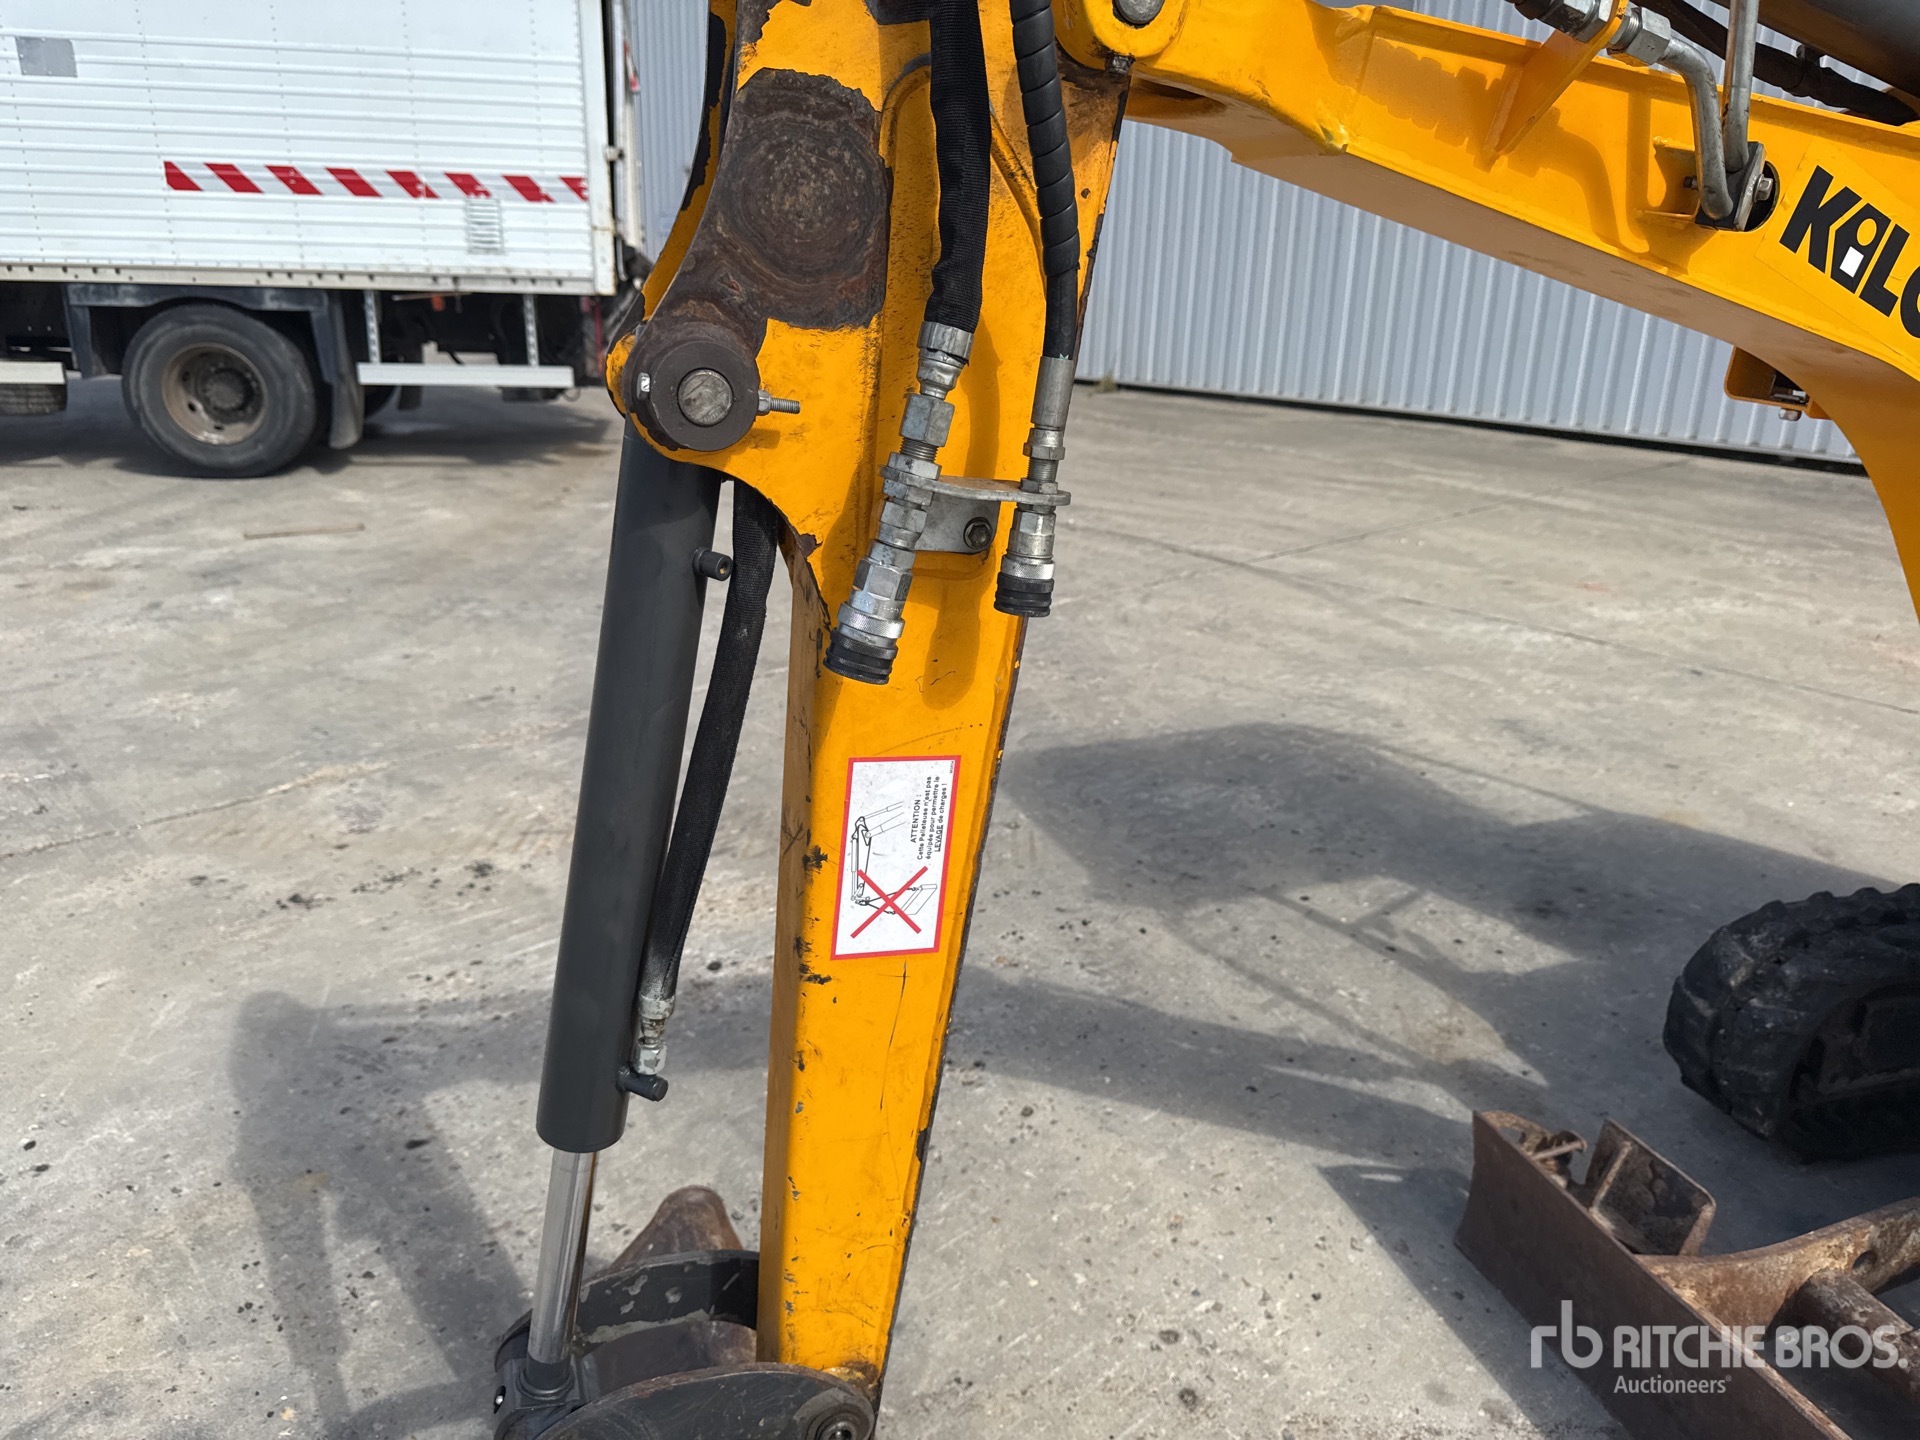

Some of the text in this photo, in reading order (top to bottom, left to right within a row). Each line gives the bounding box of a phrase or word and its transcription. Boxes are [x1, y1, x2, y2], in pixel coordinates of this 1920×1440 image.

[910, 799, 921, 843] ATTENTION
[919, 807, 928, 841] Pelleteuse
[938, 815, 943, 823] de
[934, 825, 943, 852] LEVAGE
